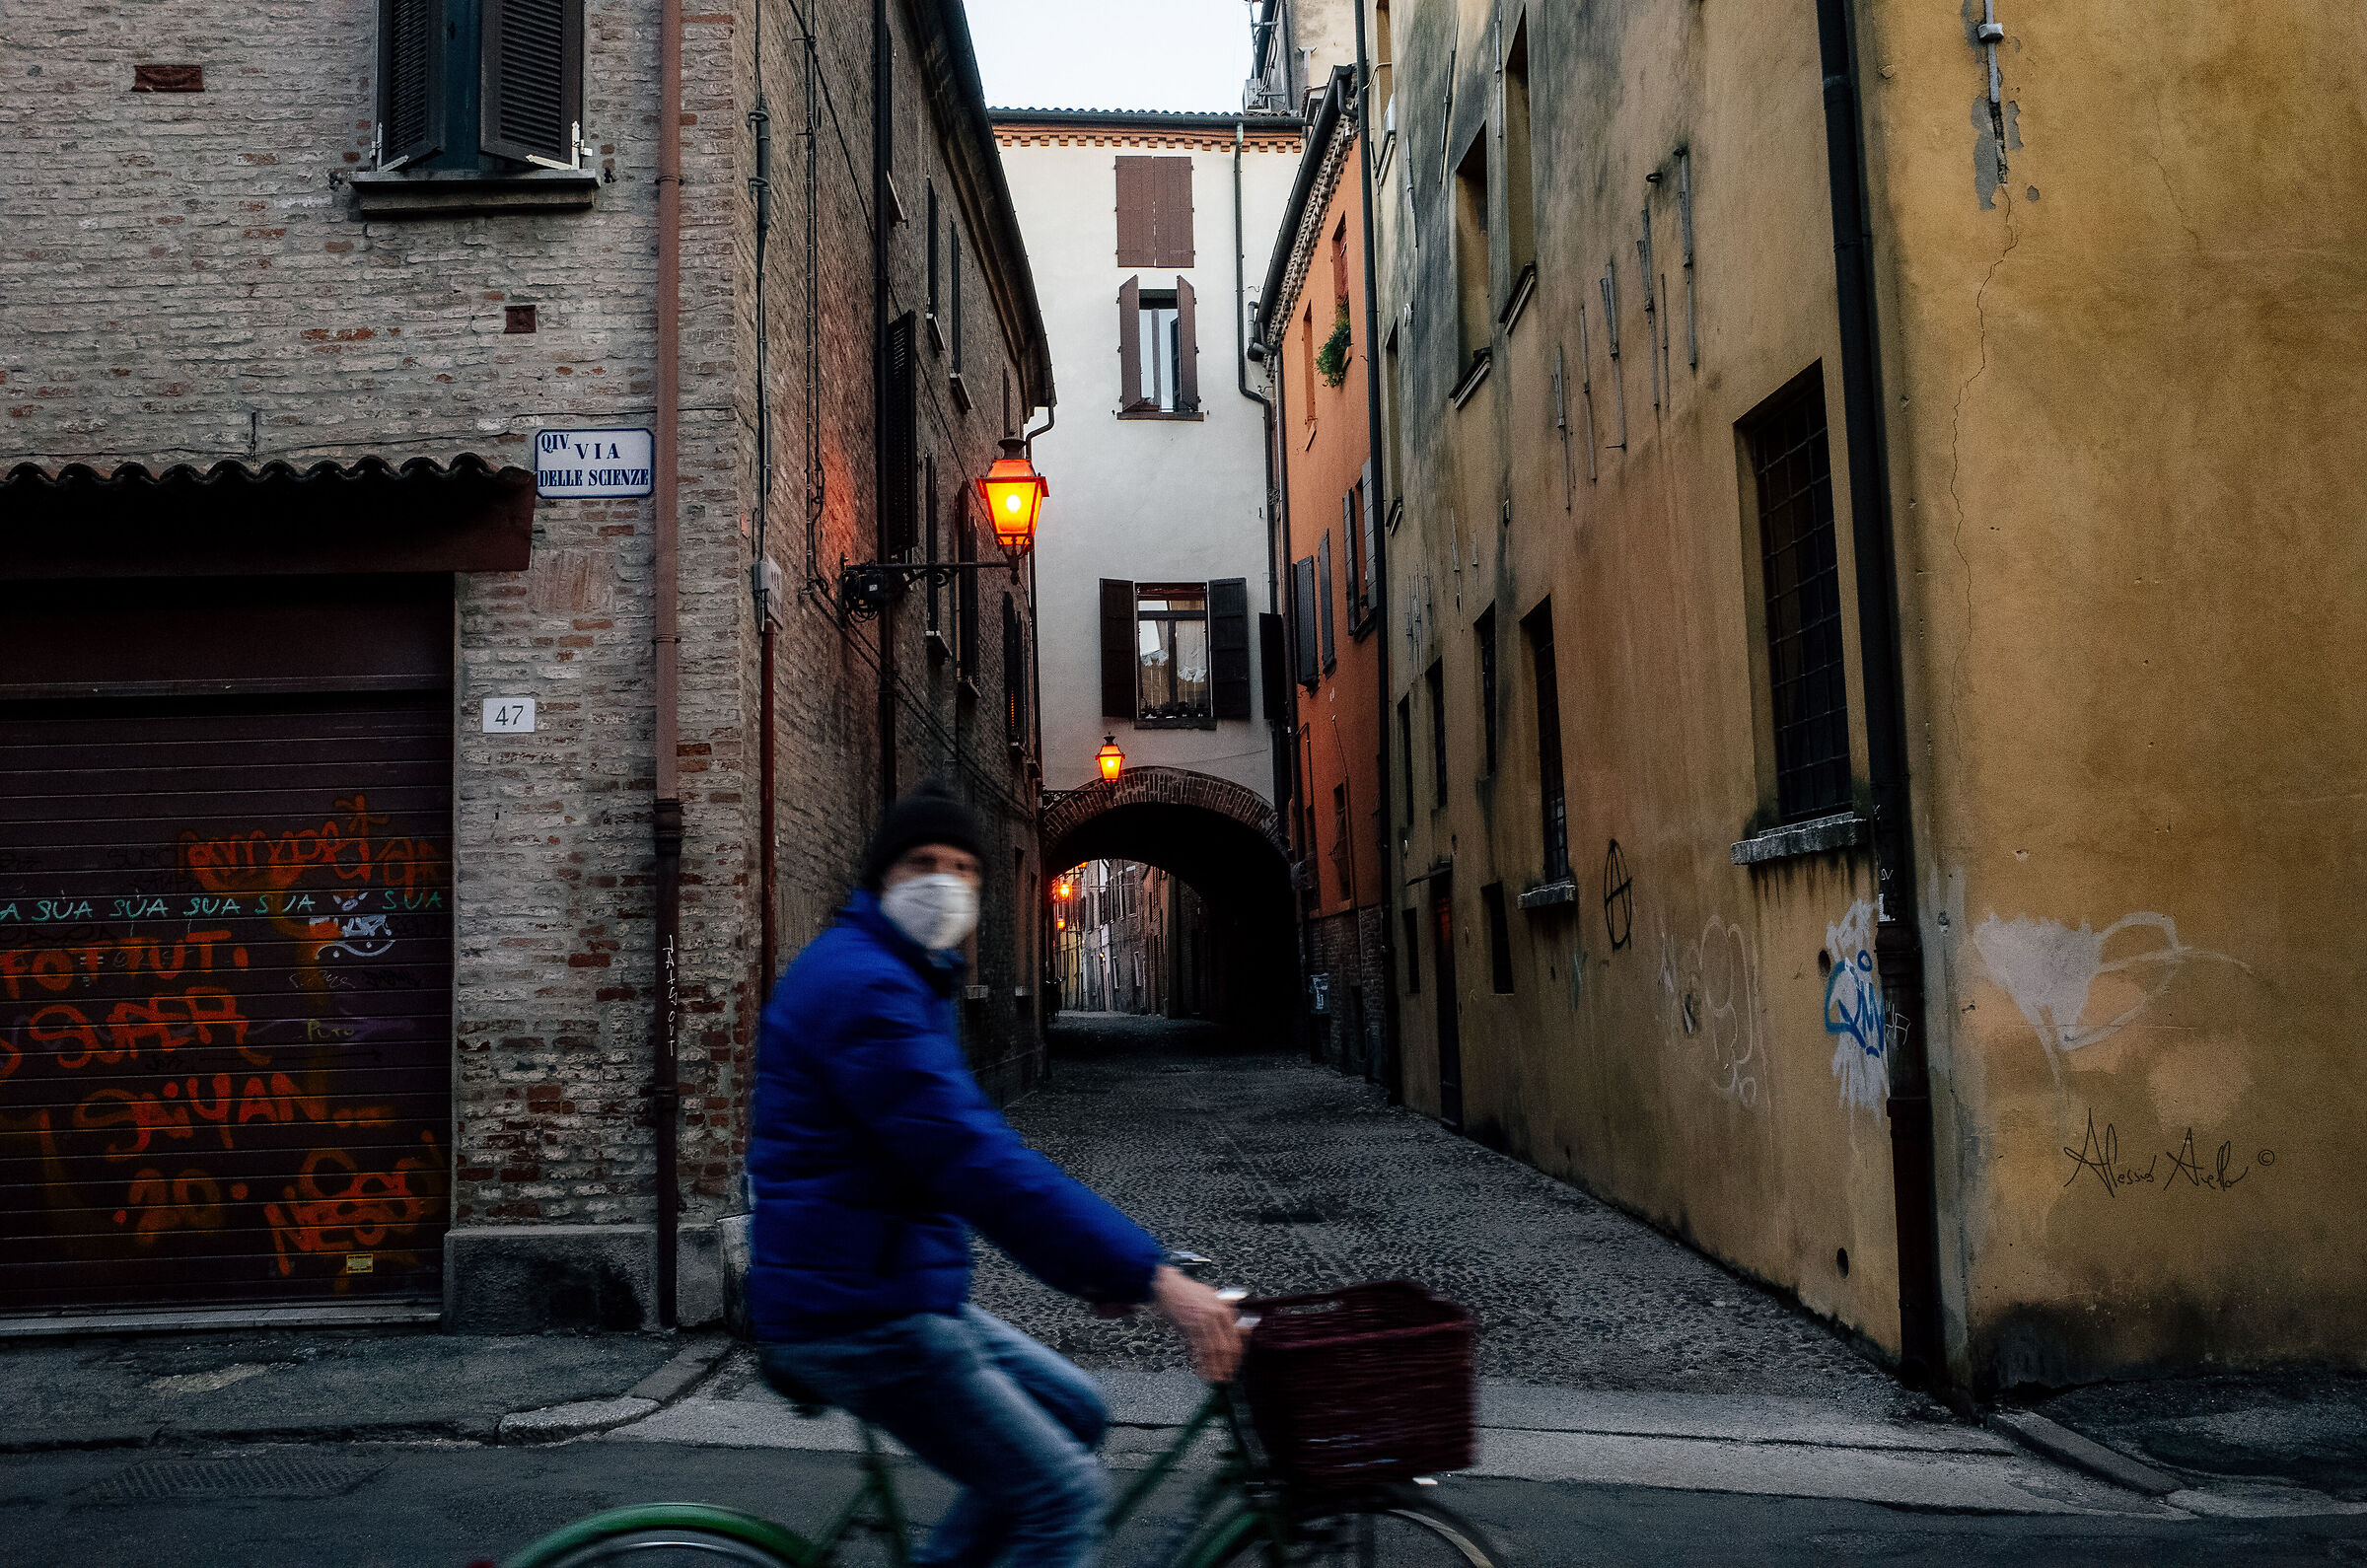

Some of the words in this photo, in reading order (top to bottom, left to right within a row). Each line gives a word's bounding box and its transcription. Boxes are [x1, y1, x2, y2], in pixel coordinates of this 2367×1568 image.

[574, 443, 620, 460] VIA
[538, 469, 583, 487] DELLE
[588, 468, 649, 485] SCIENZE
[494, 704, 524, 726] 47
[32, 899, 93, 921] SUA
[109, 898, 169, 918] SUA
[183, 897, 241, 915] SUA
[382, 891, 442, 909] SUA
